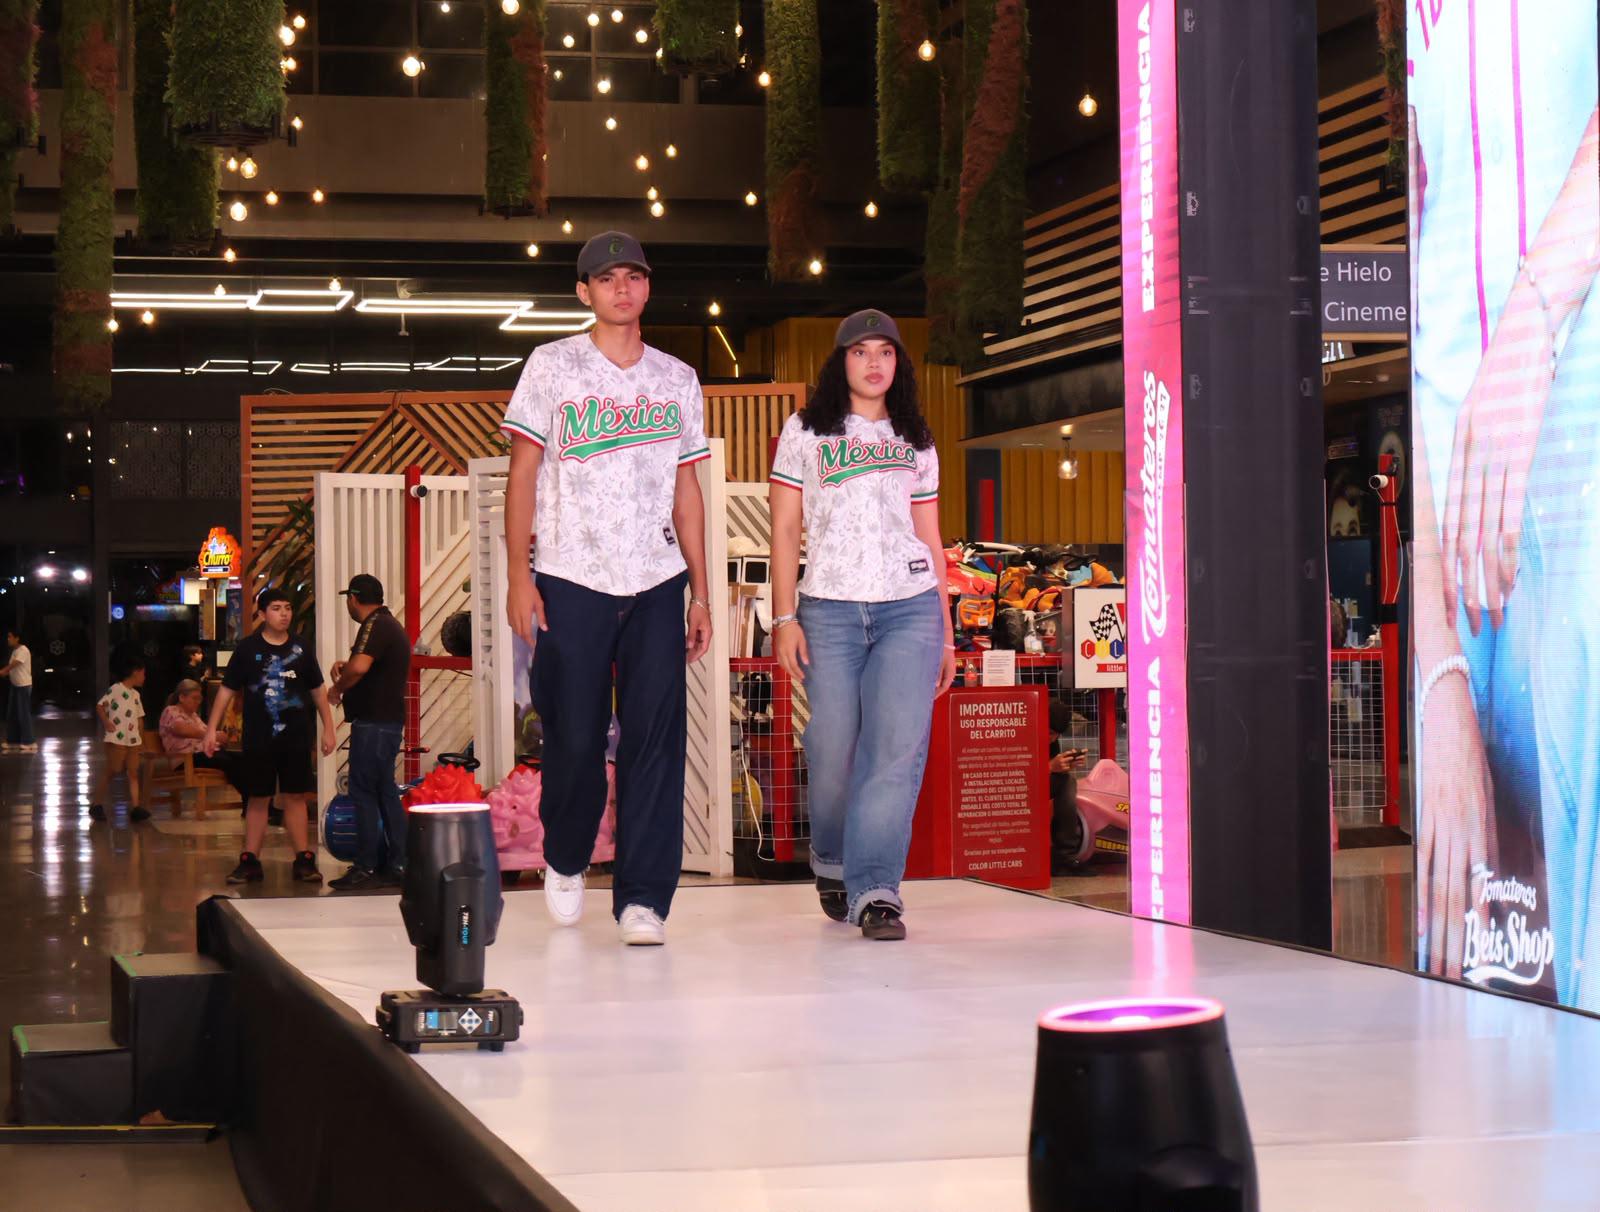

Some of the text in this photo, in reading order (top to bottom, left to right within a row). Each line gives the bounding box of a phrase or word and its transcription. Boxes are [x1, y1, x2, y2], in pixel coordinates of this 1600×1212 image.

[1138, 2, 1155, 312] EXPERIENCIA
[1338, 260, 1392, 282] Hielo
[1324, 301, 1407, 321] Cineme
[560, 395, 683, 448] México
[818, 437, 917, 477] México
[1140, 370, 1165, 645] Tomateros
[960, 702, 1028, 716] IMPORTANTE:
[960, 717, 1027, 728] USO RESPONSABLE
[970, 729, 1016, 739] DEL CARRITO
[968, 859, 1023, 871] COLOR LITTLE CARS
[1471, 862, 1537, 911] Tomateros
